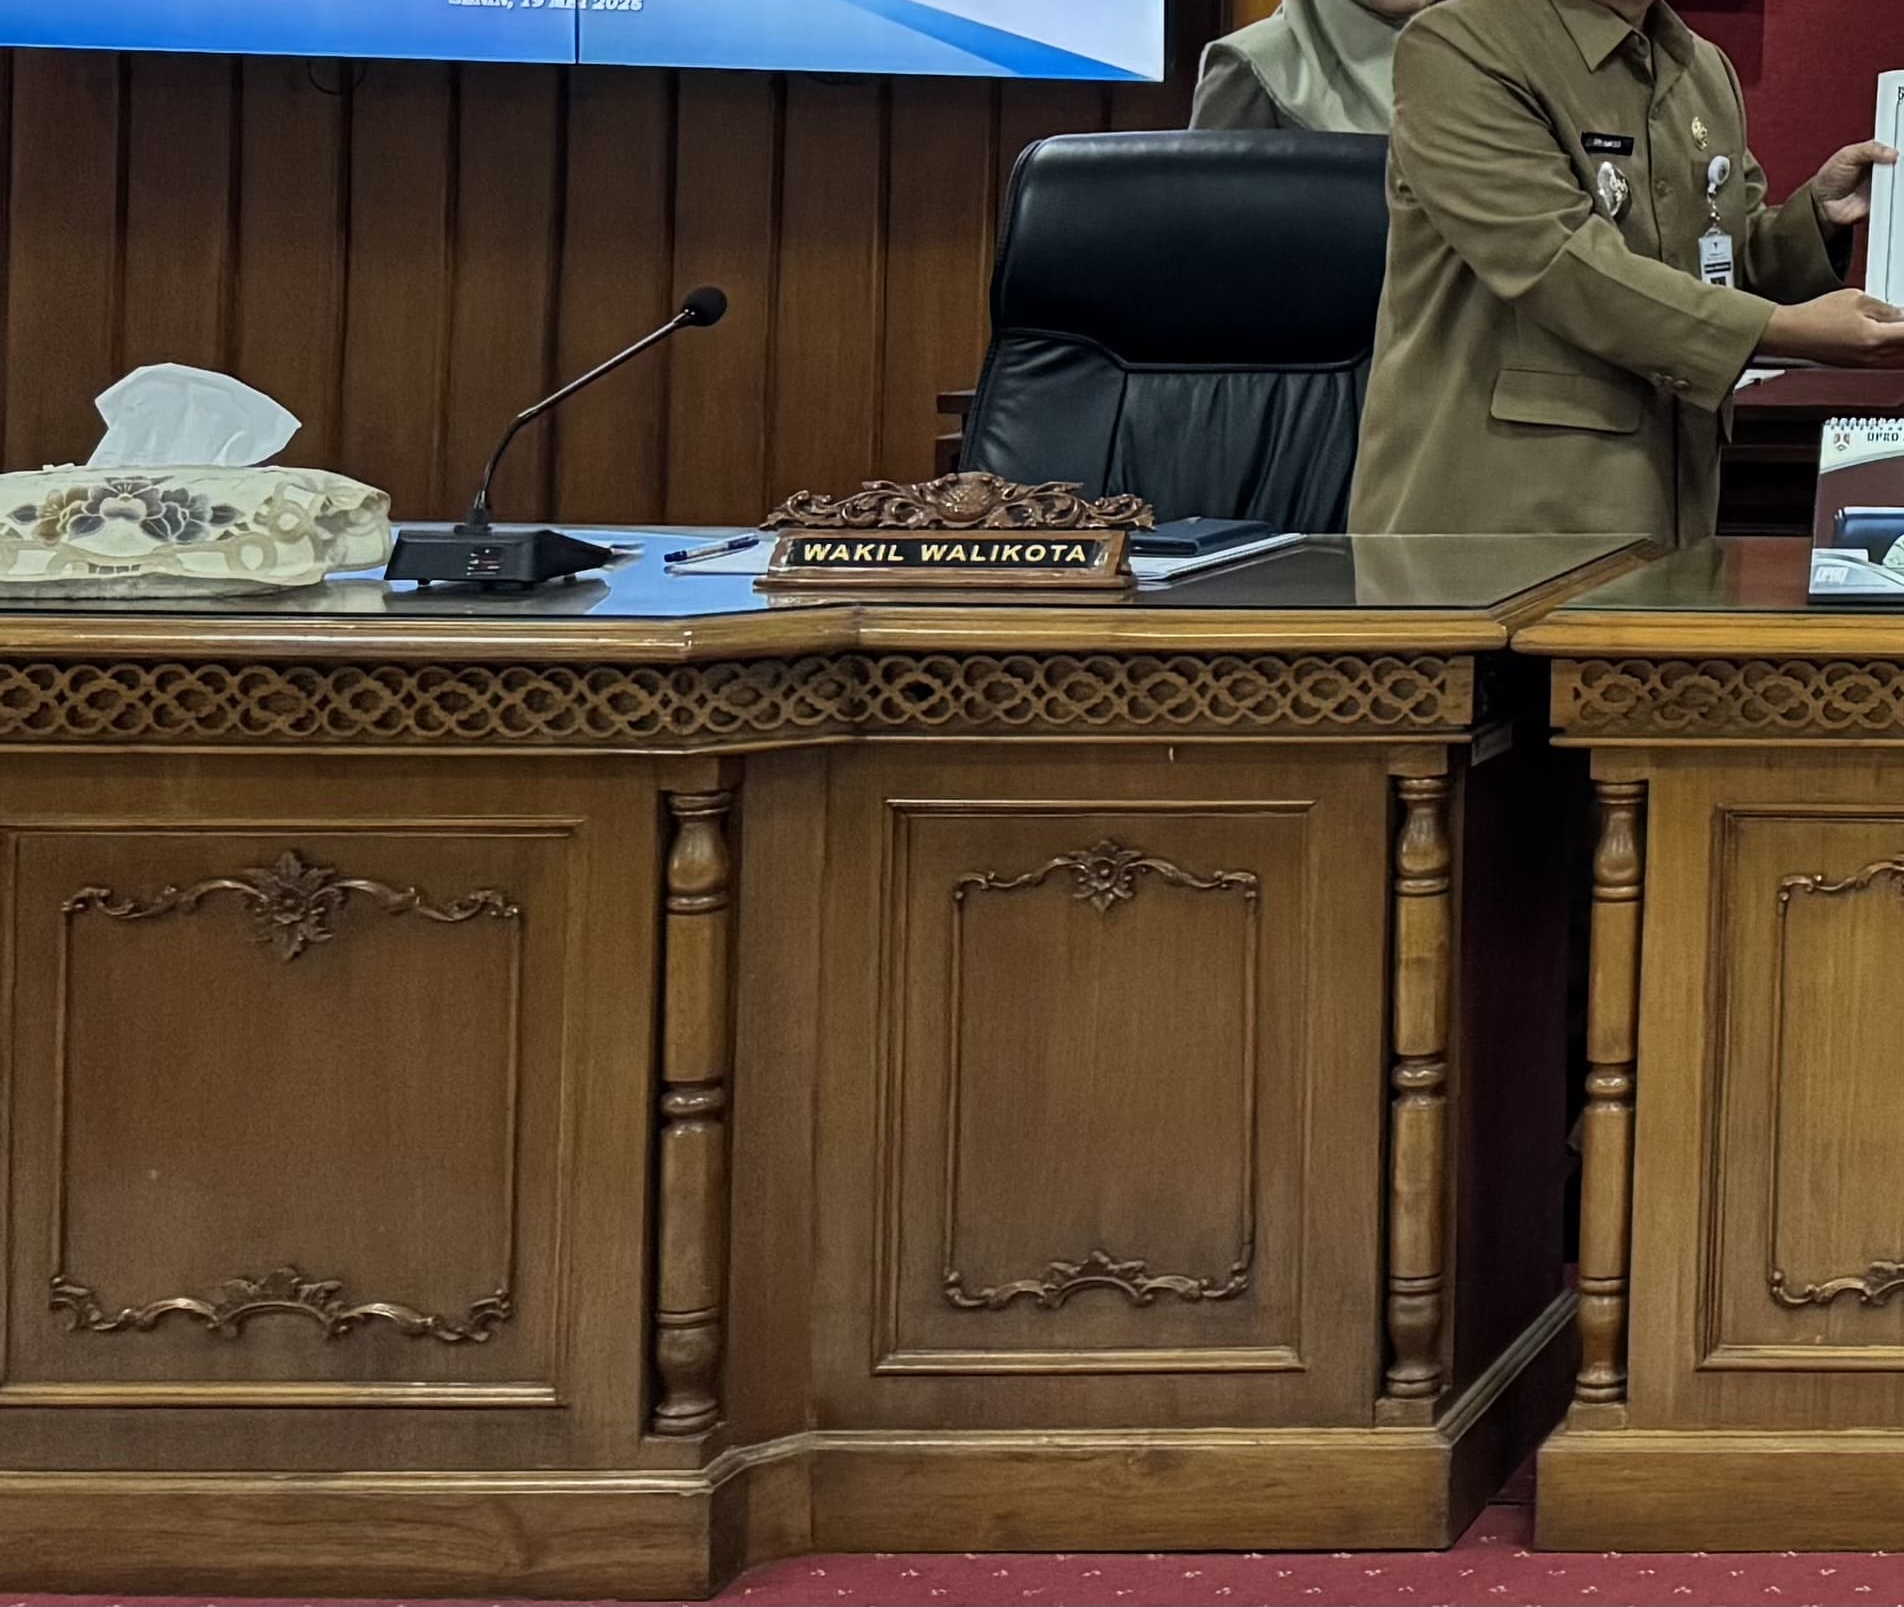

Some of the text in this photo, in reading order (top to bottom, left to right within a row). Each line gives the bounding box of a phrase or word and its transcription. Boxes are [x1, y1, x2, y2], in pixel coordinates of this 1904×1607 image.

[1867, 432, 1899, 442] DPRD
[804, 543, 1087, 563] WAKIL WALIKOTA
